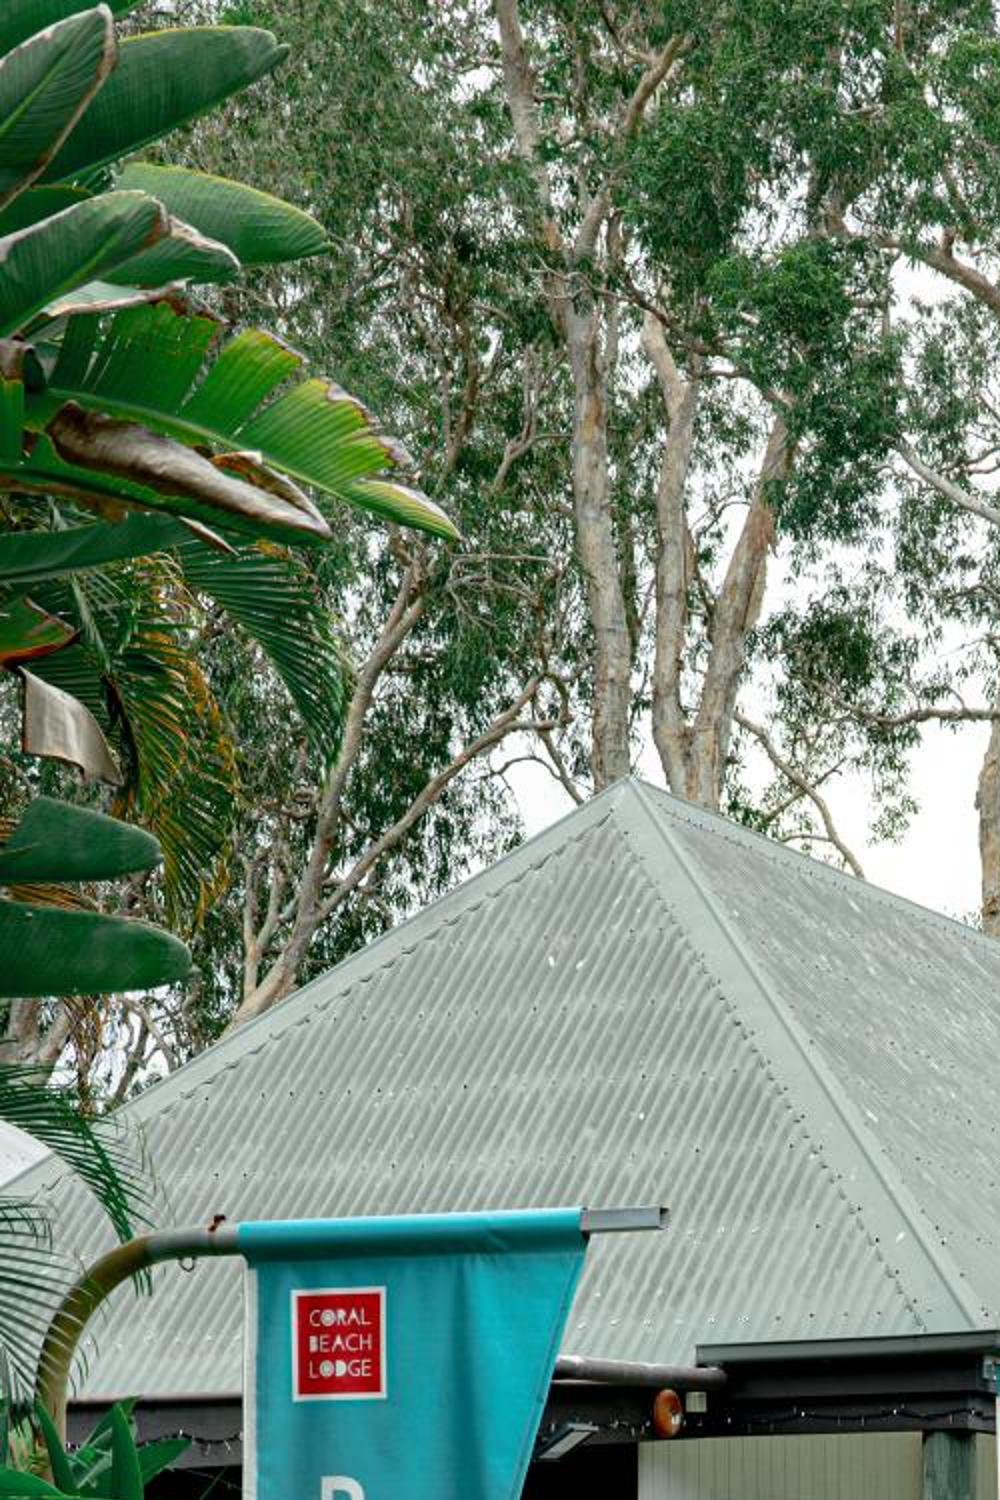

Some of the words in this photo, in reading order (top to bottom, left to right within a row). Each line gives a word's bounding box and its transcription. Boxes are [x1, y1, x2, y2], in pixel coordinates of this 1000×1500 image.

[309, 1307, 372, 1327] CORAL
[309, 1333, 372, 1353] BEACH
[308, 1359, 372, 1379] LODGE
